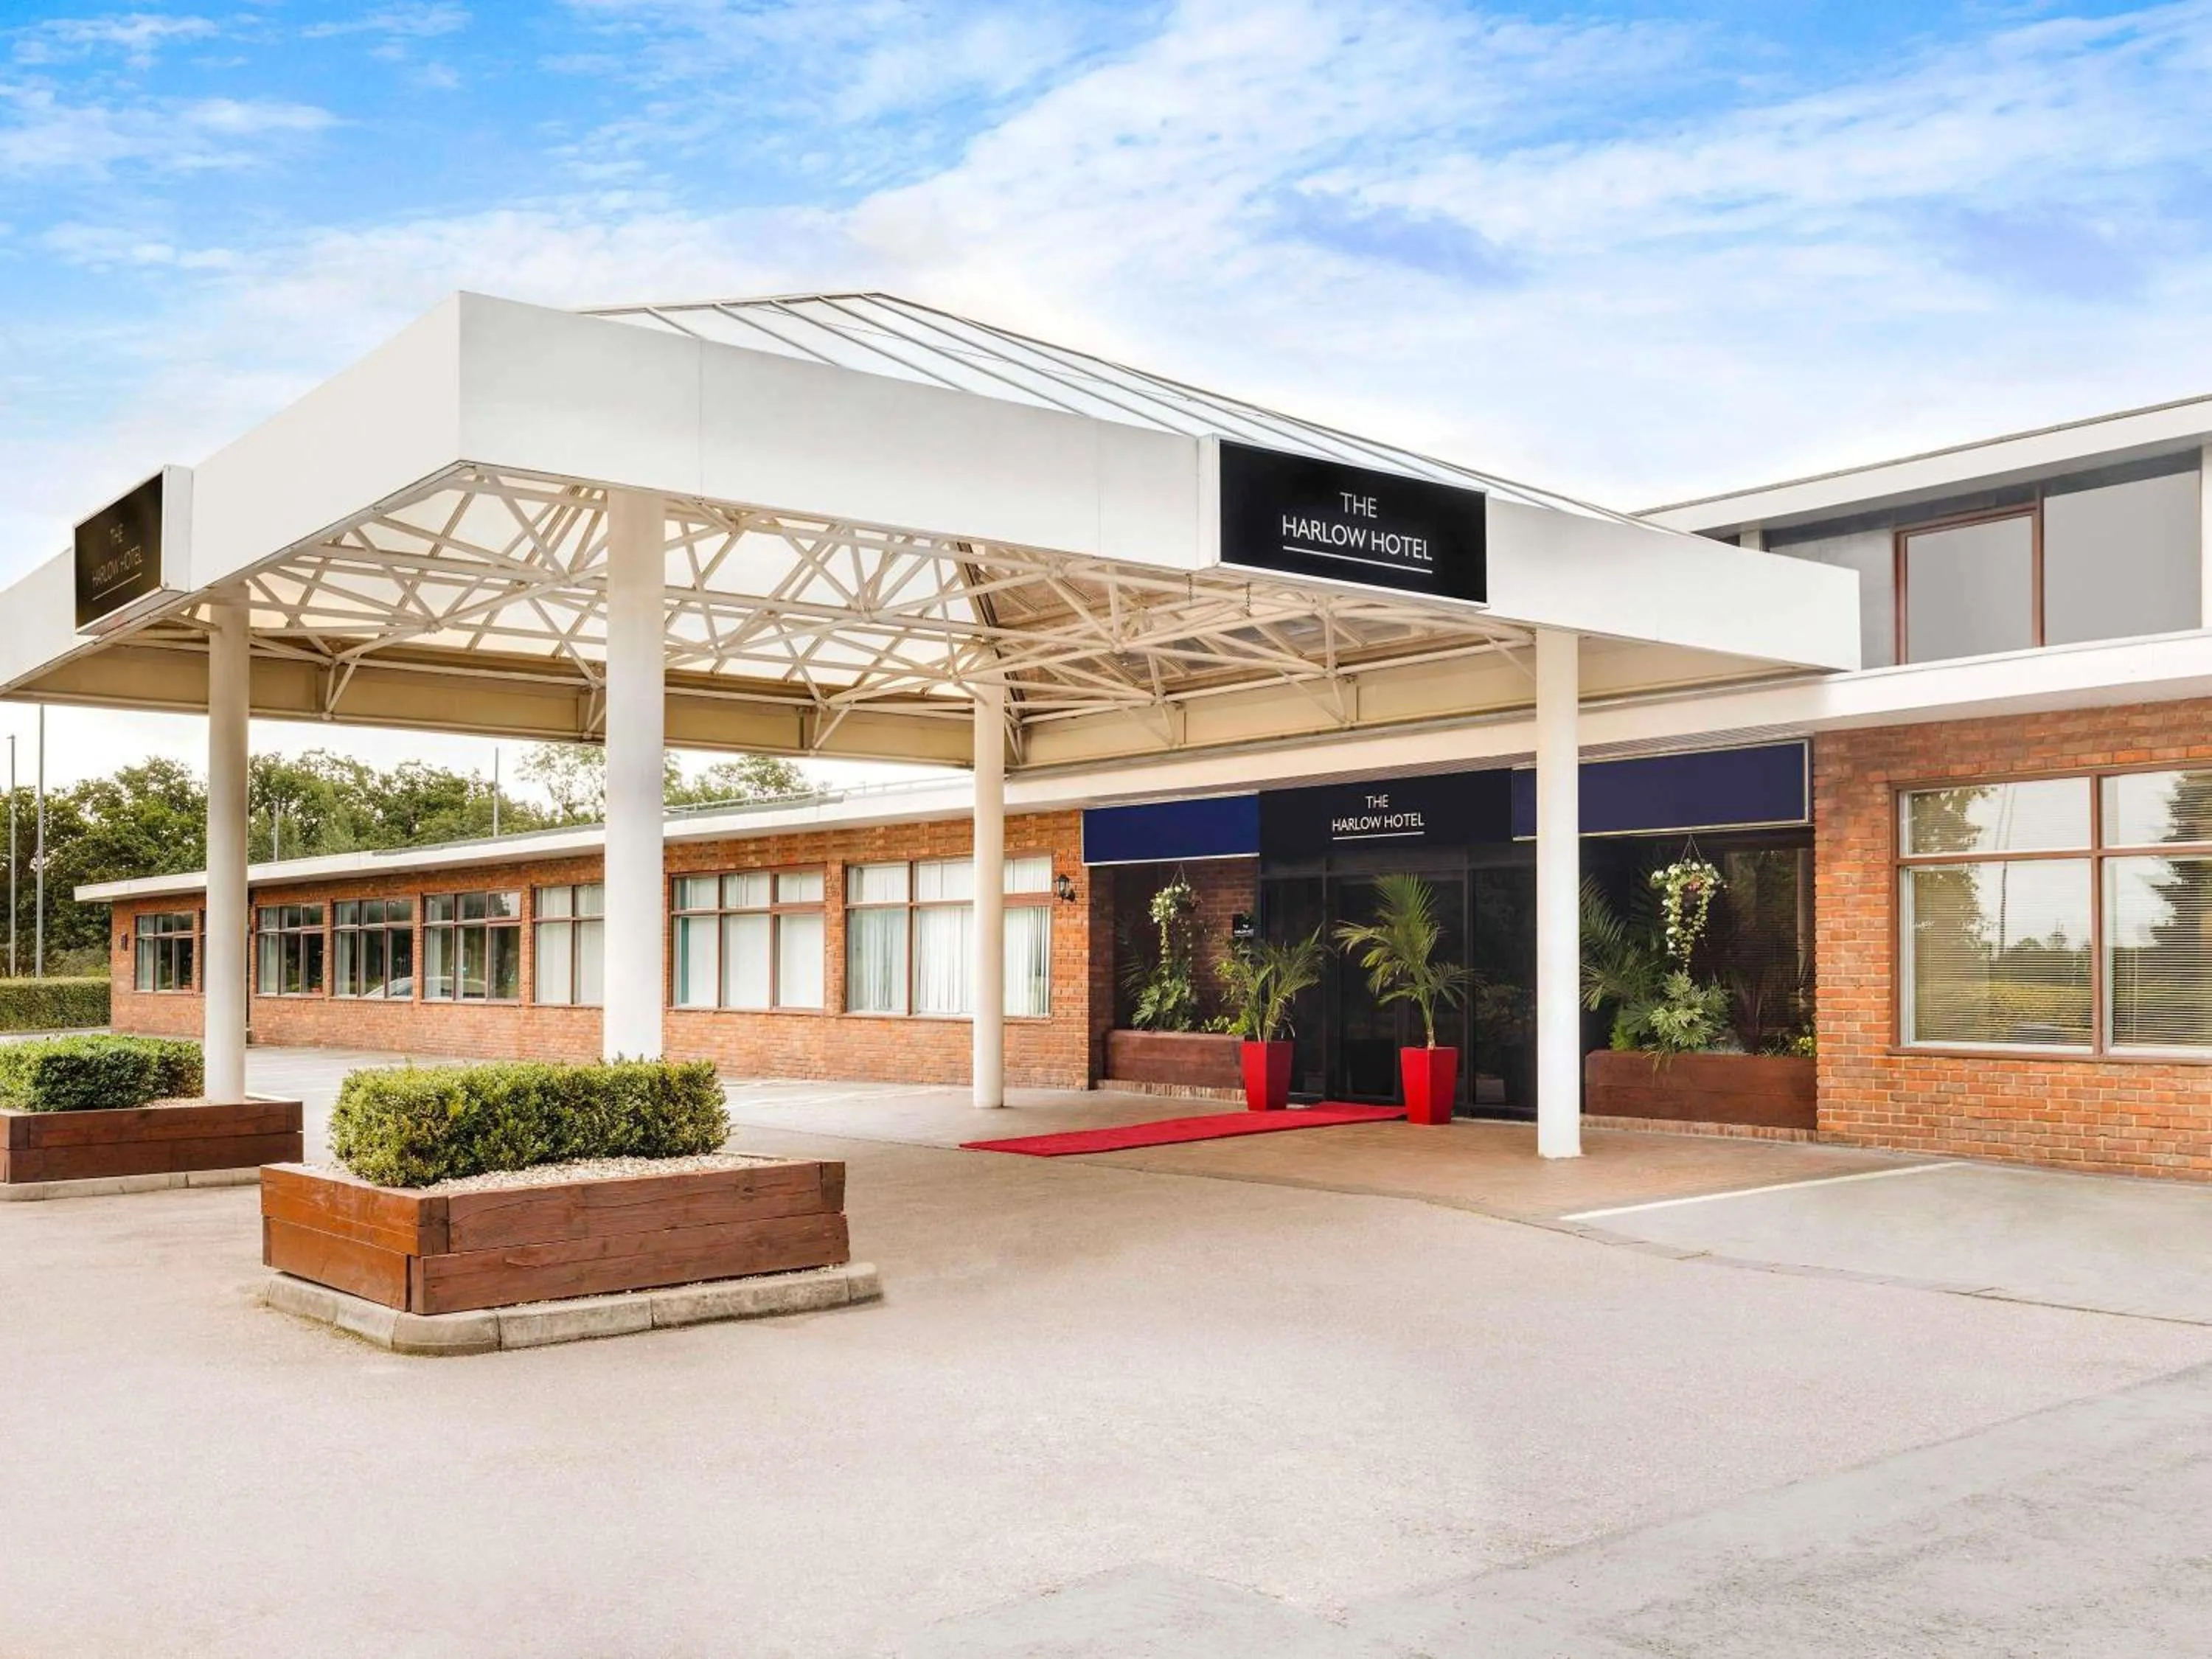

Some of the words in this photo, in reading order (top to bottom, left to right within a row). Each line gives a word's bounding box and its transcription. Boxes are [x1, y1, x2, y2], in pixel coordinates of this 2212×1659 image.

[1339, 491, 1377, 518] THE
[1281, 515, 1366, 548] HARLOW
[1371, 530, 1433, 561] HOTEL
[1365, 794, 1389, 809] THE
[1332, 816, 1382, 832] HARLOW
[1384, 812, 1425, 828] HOTEL
